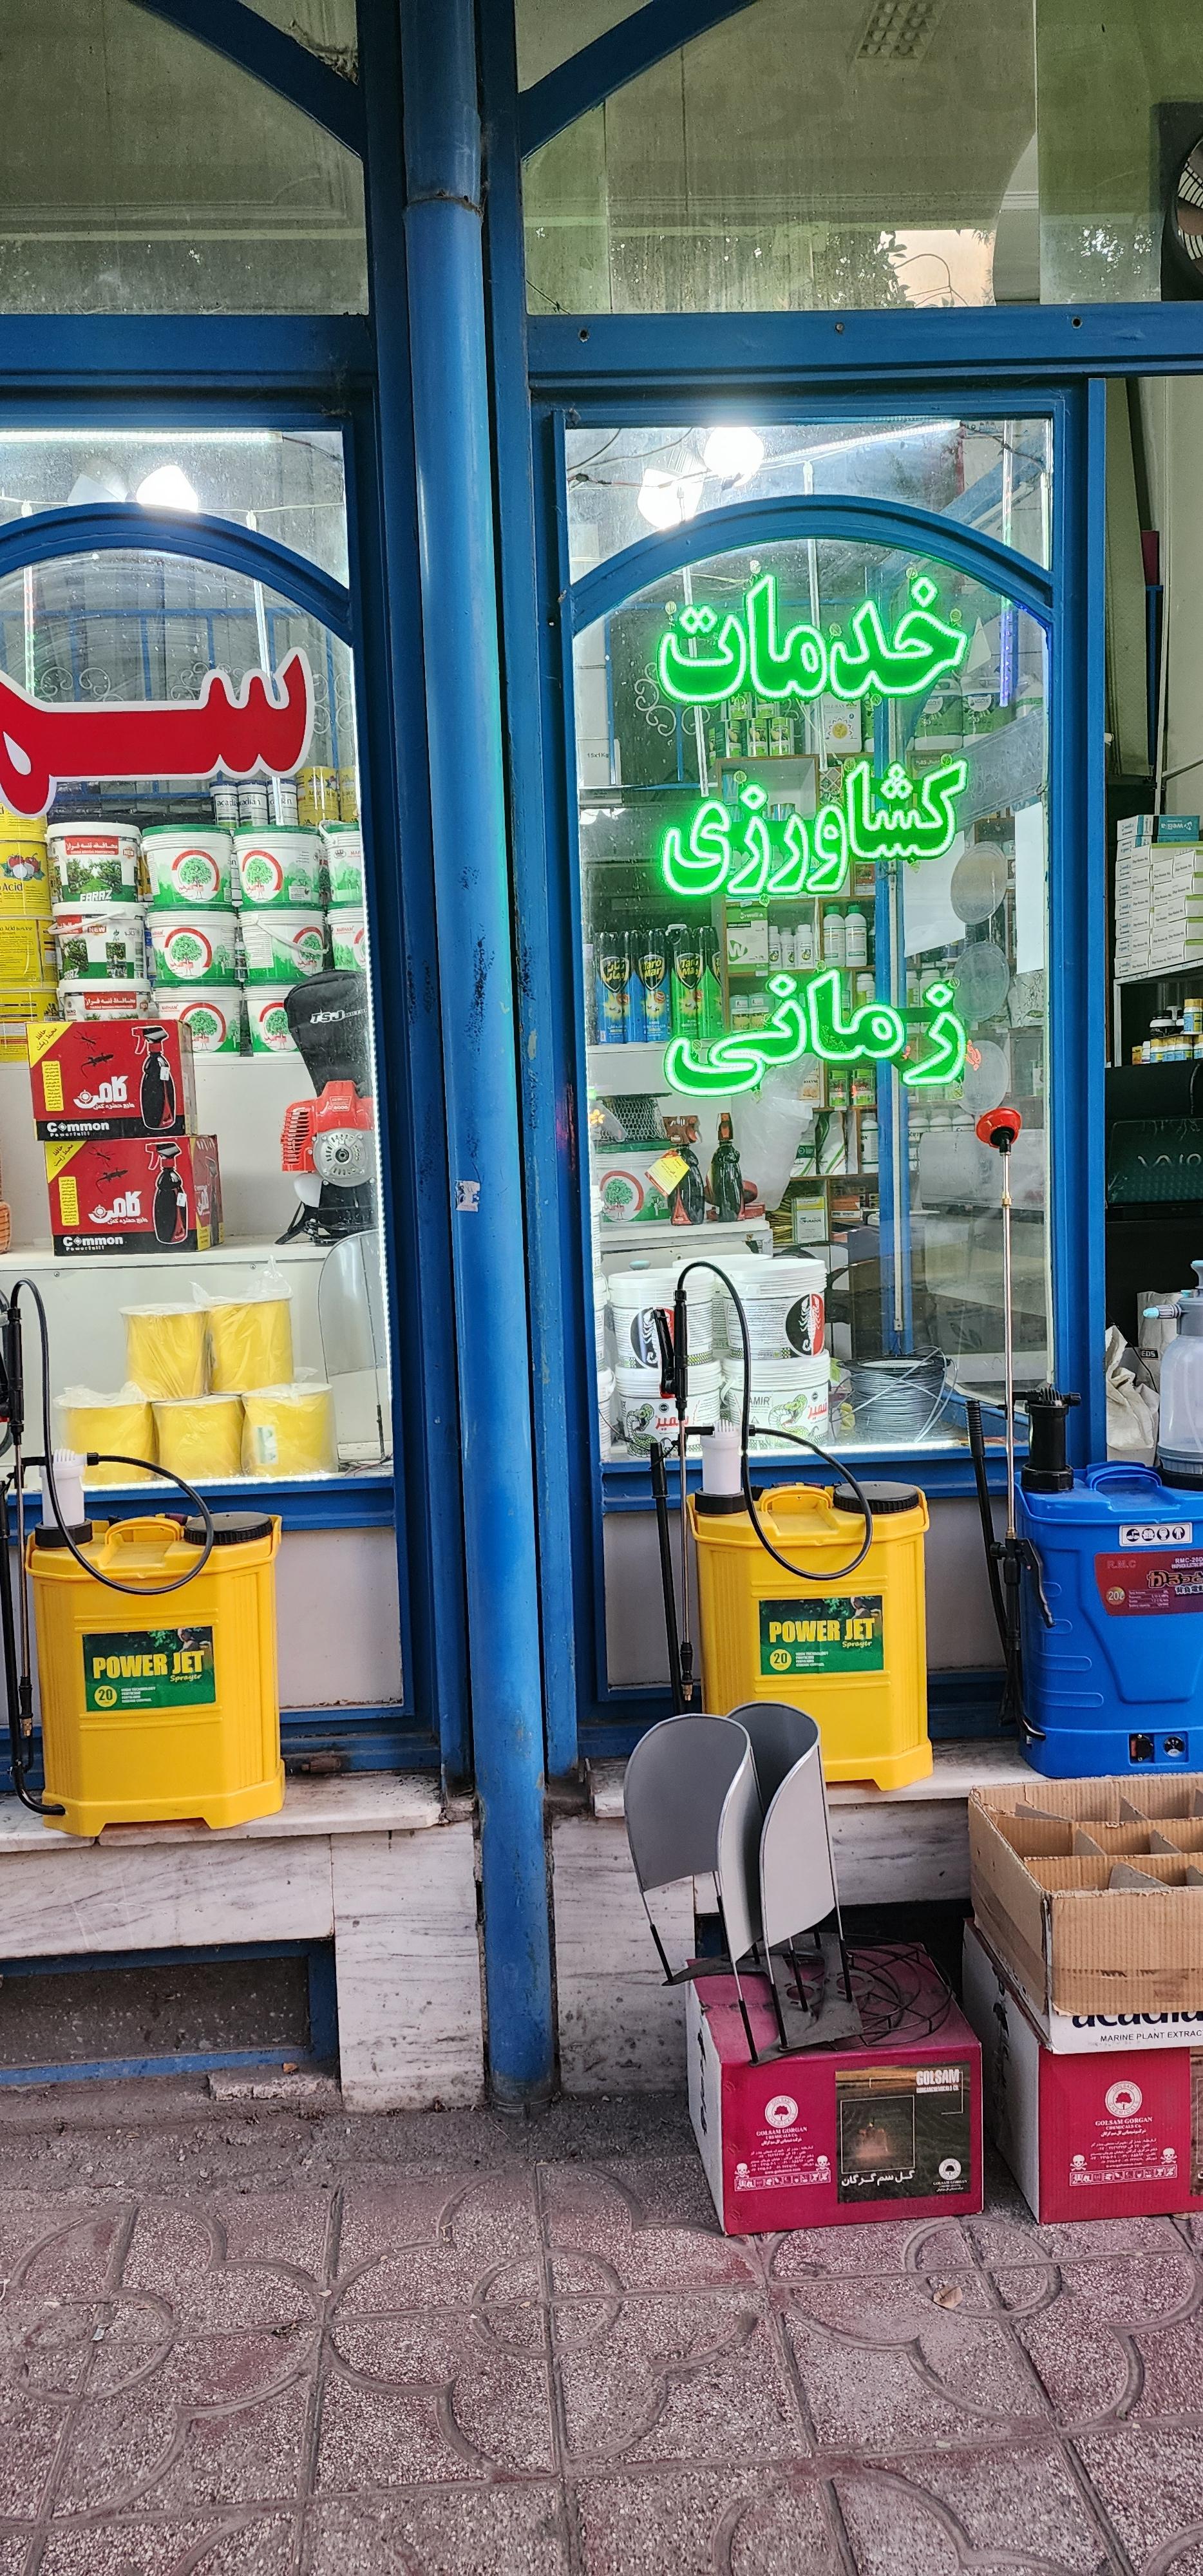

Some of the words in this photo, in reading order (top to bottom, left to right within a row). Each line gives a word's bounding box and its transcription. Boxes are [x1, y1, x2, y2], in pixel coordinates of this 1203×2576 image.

[657, 573, 969, 703] خدمات
[661, 759, 969, 896] کشاورزی
[3, 882, 23, 891] Acid
[81, 890, 113, 902] FARAZ
[663, 968, 967, 1096] زمانی
[769, 1620, 840, 1643] POWER
[845, 1618, 875, 1641] JET
[93, 1653, 168, 1679] POWER
[172, 1651, 205, 1674] JET
[773, 1653, 788, 1664] 20
[169, 1674, 202, 1683] Sprayer
[98, 1689, 113, 1701] 20
[1101, 2034, 1134, 2042] MARINE
[1137, 2032, 1164, 2040] PLANT
[916, 2069, 959, 2085] GOLSAM
[841, 2173, 876, 2186] گرگان
[877, 2174, 894, 2186] سم
[895, 2170, 915, 2183] گل
